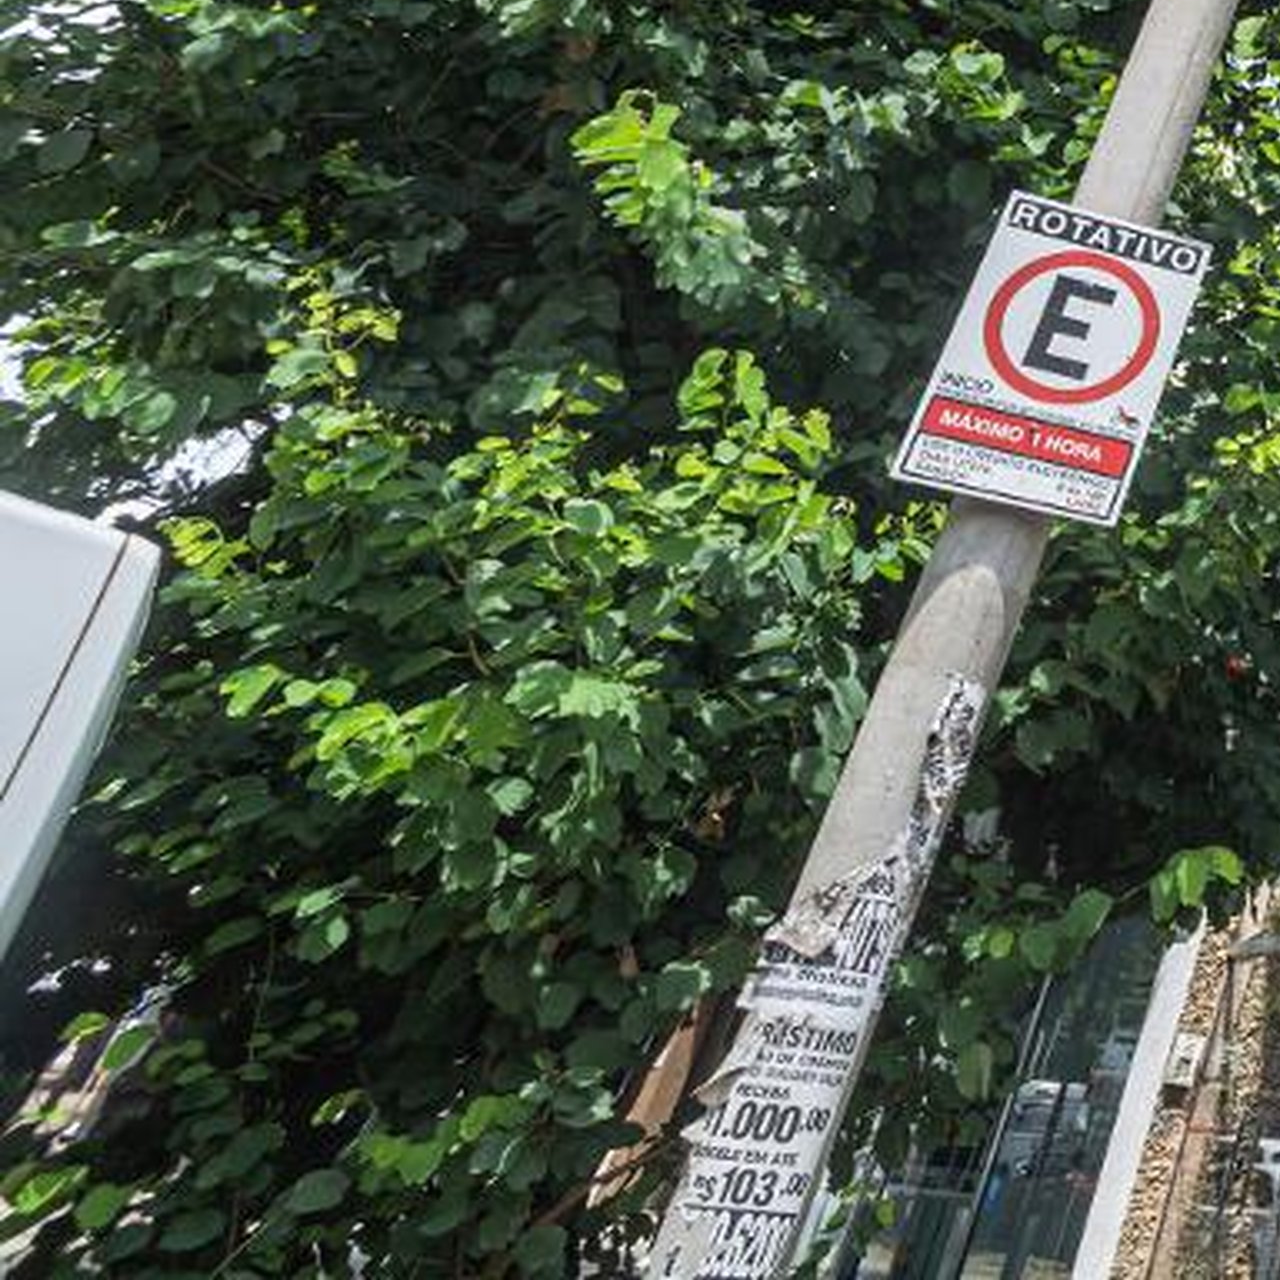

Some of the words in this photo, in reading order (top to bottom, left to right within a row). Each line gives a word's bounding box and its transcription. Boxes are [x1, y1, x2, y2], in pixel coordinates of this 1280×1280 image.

[1012, 200, 1199, 271] ROTATIVO
[1021, 273, 1117, 381] E
[939, 408, 1024, 441] MÁXIMO
[1031, 430, 1041, 446] 1
[1045, 434, 1101, 462] HORA
